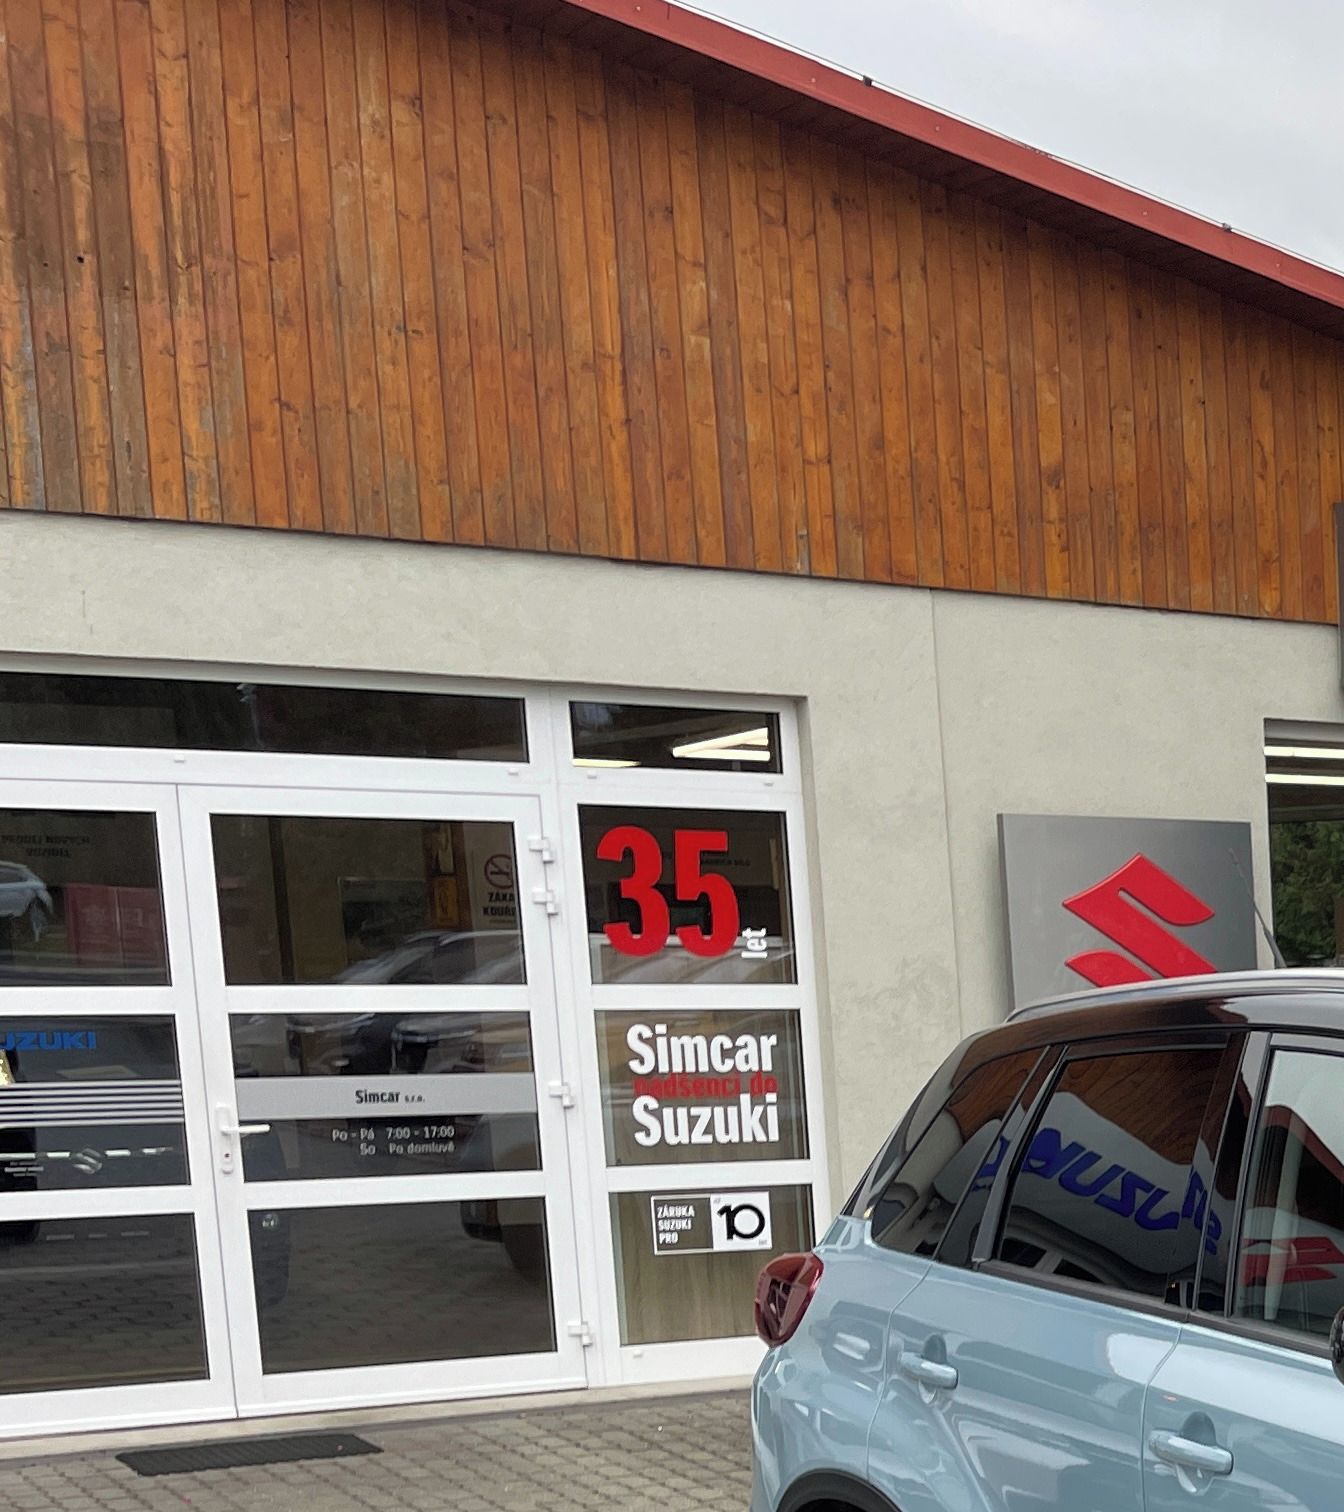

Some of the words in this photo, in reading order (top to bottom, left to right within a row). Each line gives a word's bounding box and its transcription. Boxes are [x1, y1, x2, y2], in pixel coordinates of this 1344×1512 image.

[488, 891, 515, 902] ZÁKA
[597, 825, 739, 957] 35
[741, 928, 767, 958] let
[0, 1031, 96, 1050] UZUKI
[627, 1024, 777, 1074] Simcar
[750, 1070, 778, 1096] do
[355, 1089, 400, 1104] Simcar
[633, 1094, 779, 1146] Suzuki
[332, 1128, 348, 1141] Po
[385, 1126, 411, 1139] 7:00
[423, 1125, 455, 1138] 17:00
[360, 1142, 376, 1155] So
[657, 1204, 695, 1218] ZÁRUKA
[658, 1218, 692, 1231] SUZUKI
[717, 1203, 765, 1240] 10
[659, 1231, 679, 1244] PRO
